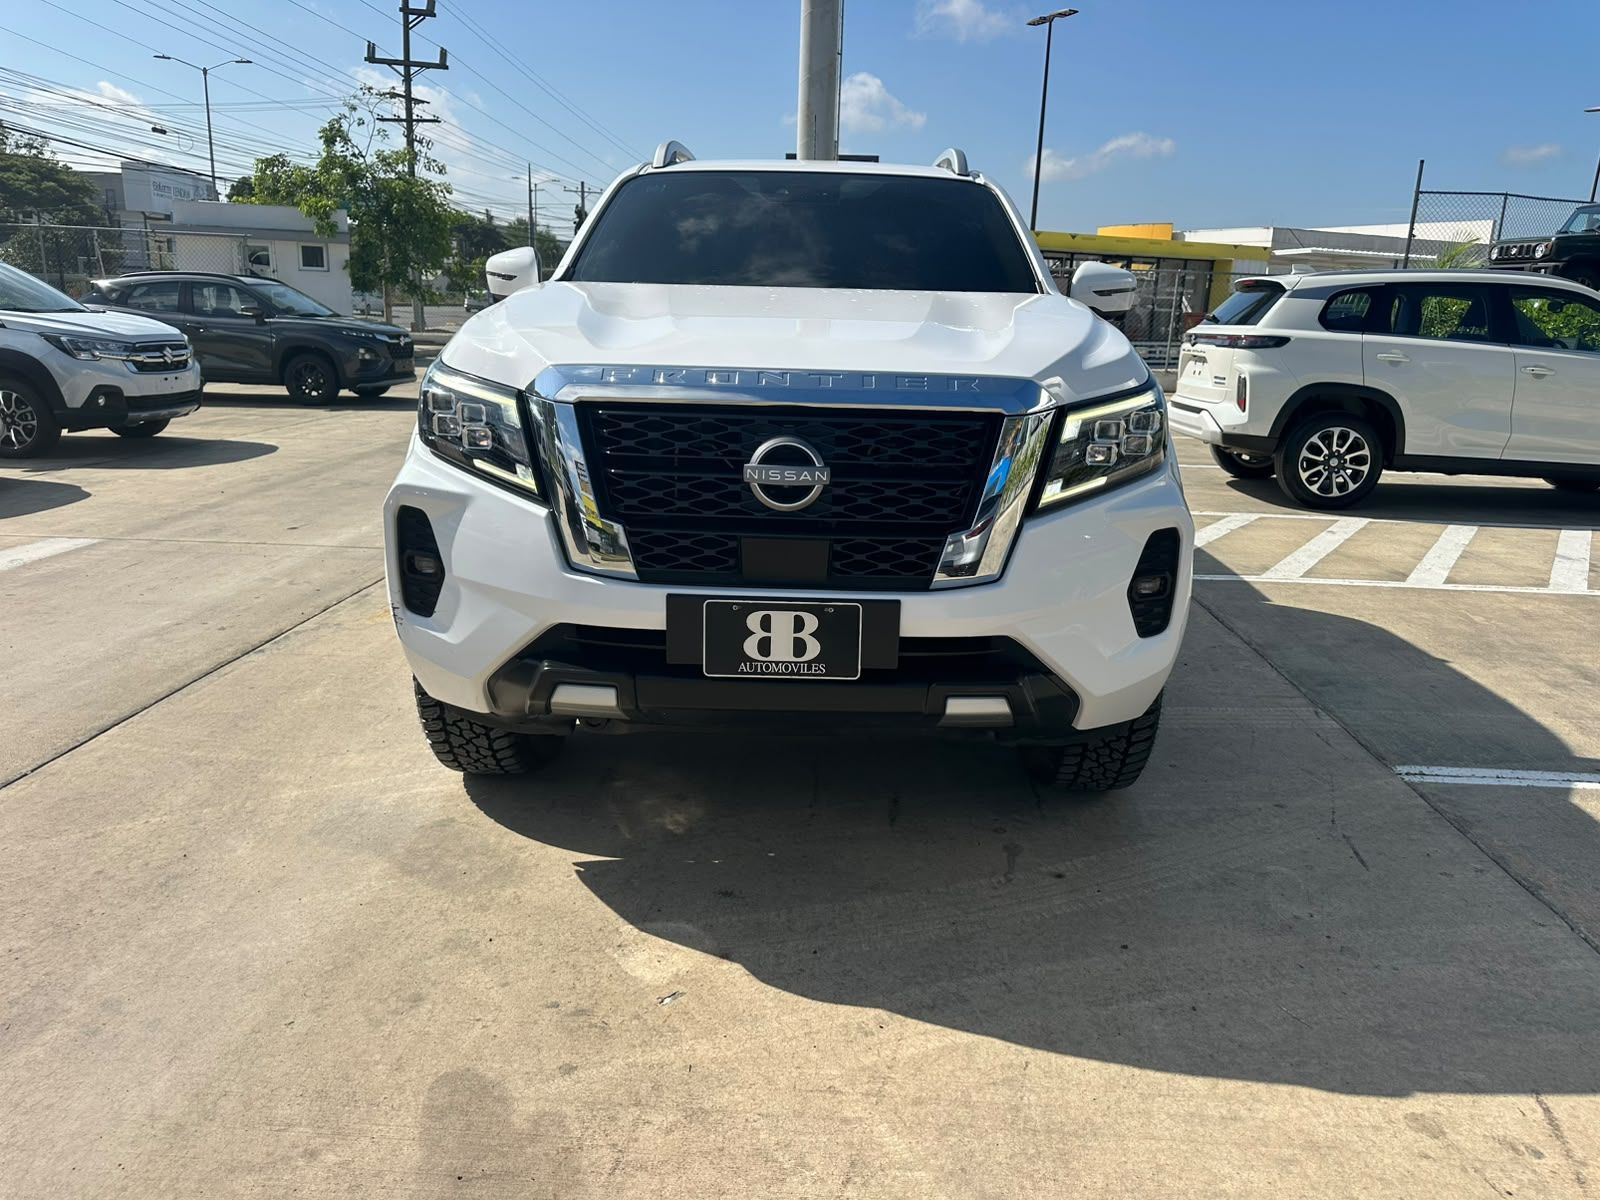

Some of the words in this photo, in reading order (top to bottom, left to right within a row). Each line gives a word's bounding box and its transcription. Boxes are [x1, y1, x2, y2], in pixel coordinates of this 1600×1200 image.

[600, 366, 982, 393] FRONTIER
[746, 468, 827, 481] NISSAN
[738, 662, 826, 674] AUTOMOVILES
